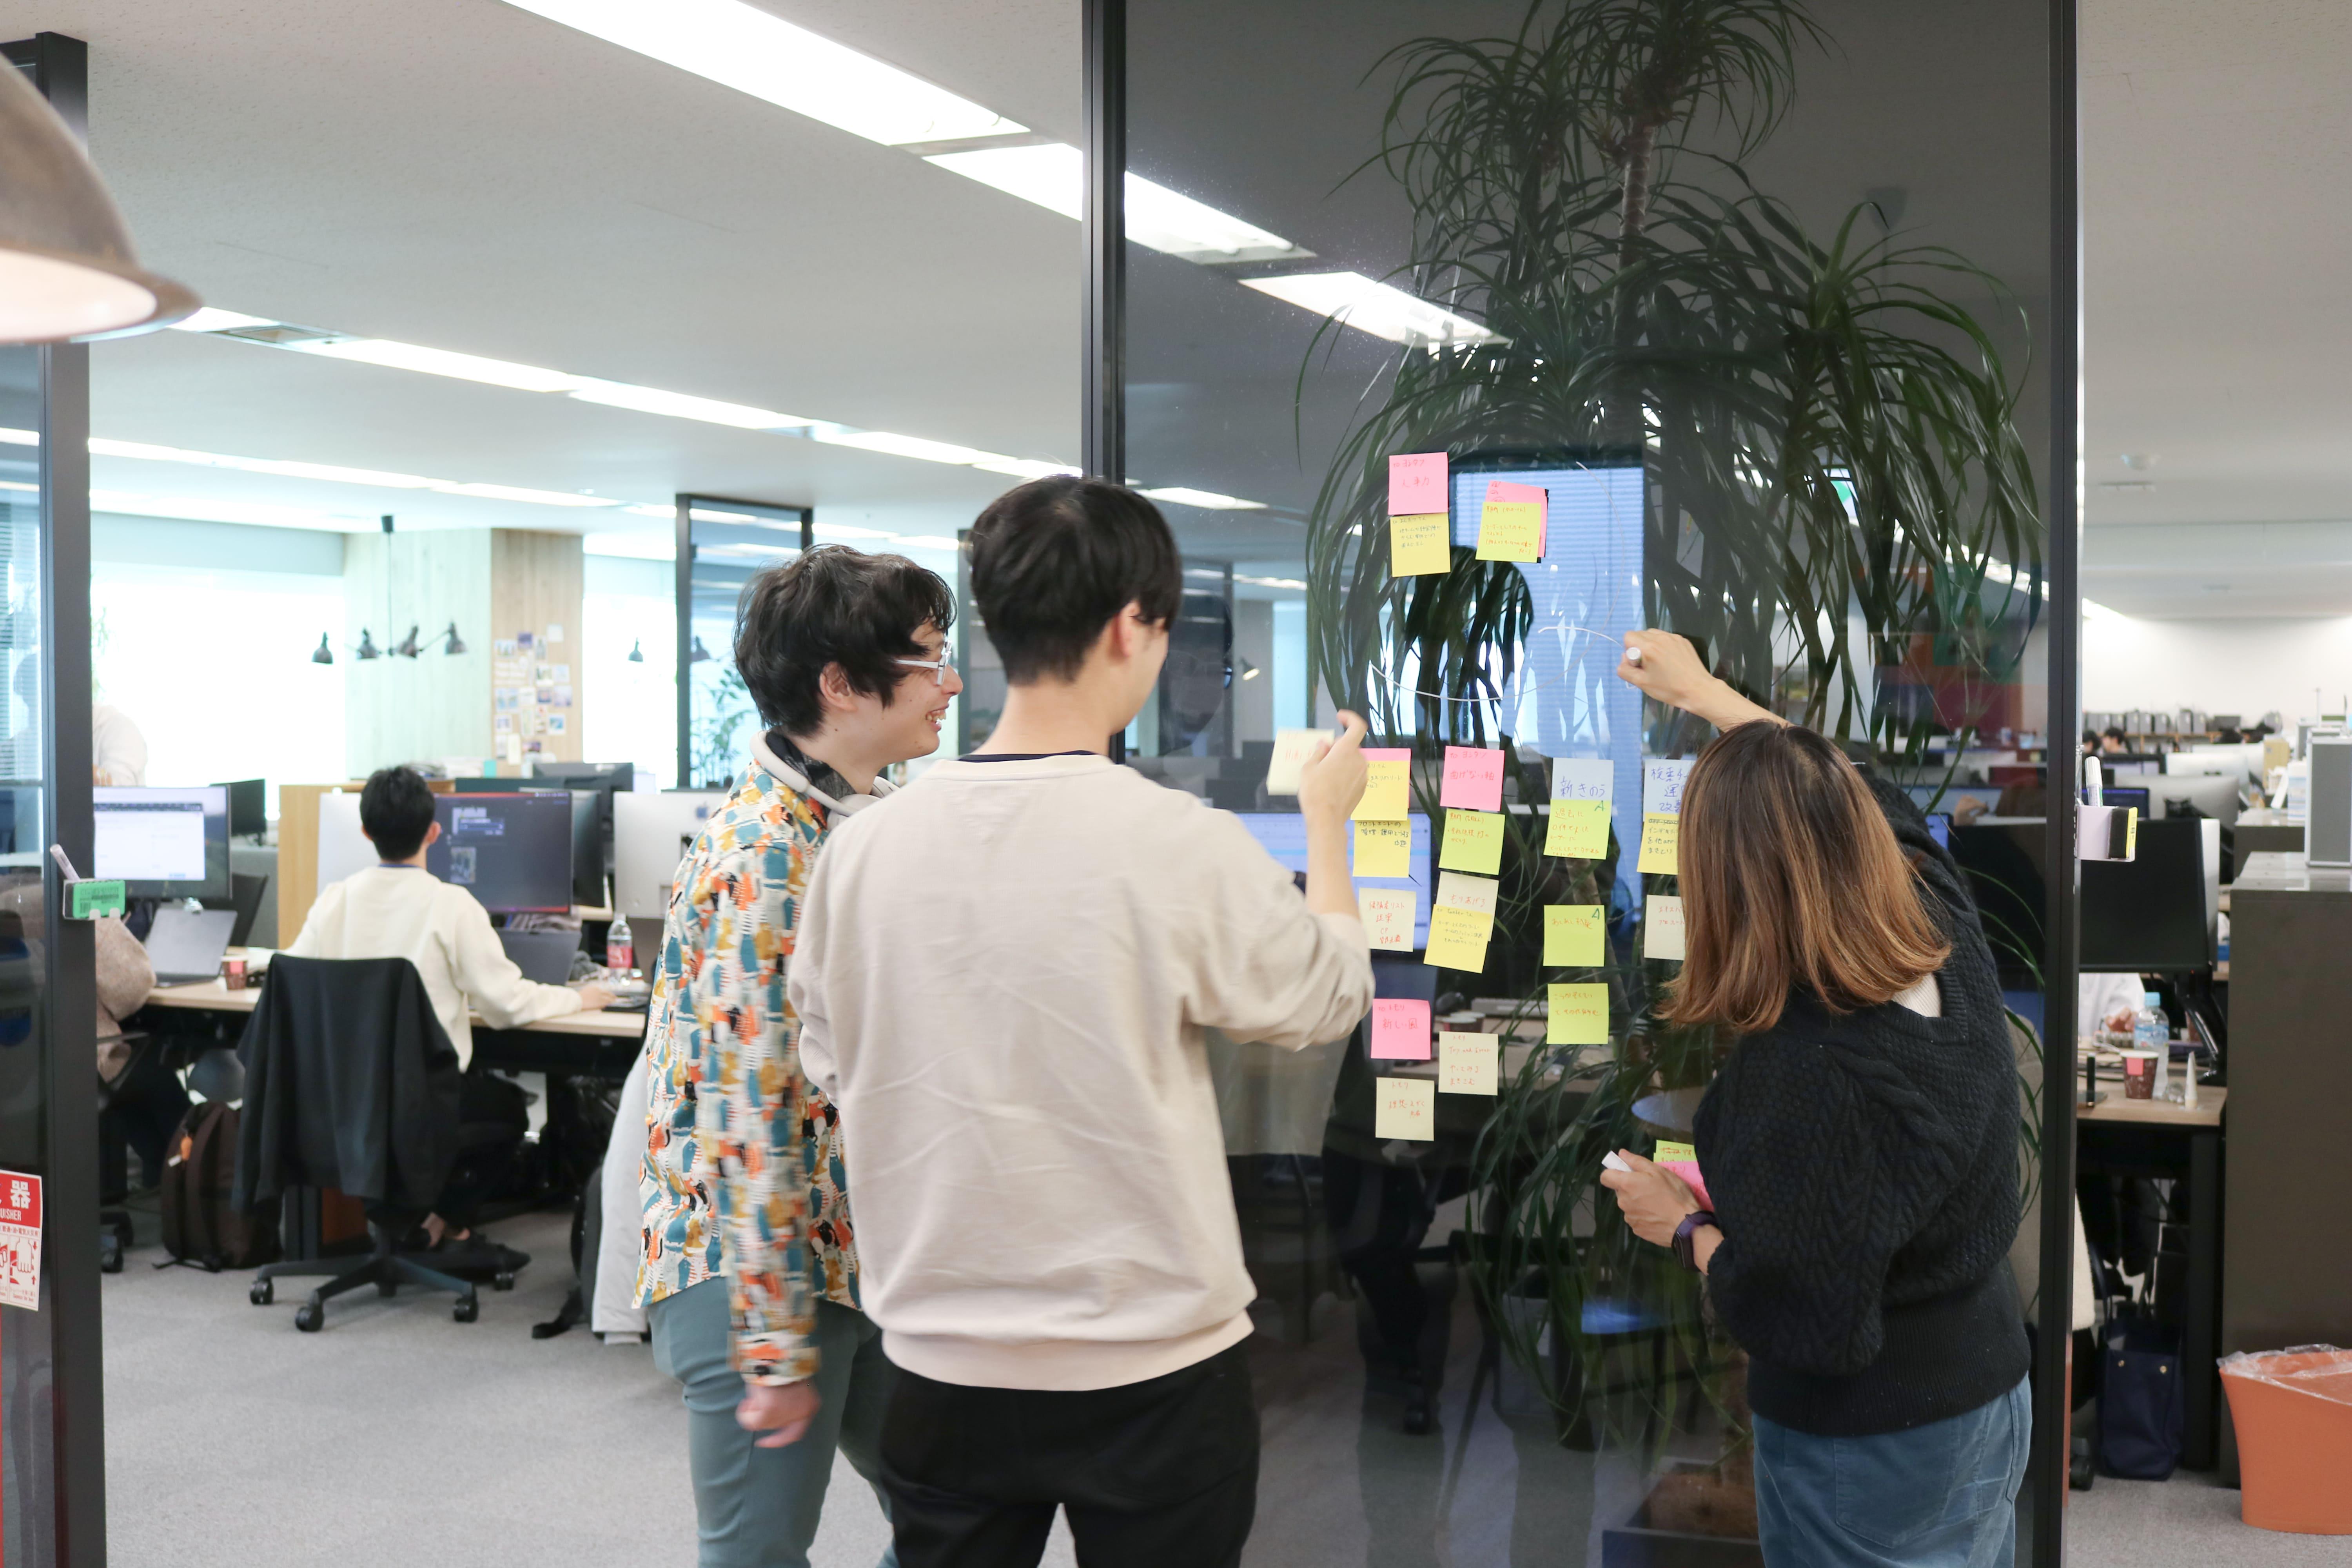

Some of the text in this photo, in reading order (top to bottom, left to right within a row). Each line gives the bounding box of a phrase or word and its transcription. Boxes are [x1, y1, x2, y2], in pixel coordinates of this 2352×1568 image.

[1594, 800, 1604, 811] A
[1592, 908, 1600, 920] A
[0, 1208, 21, 1221] UISHER
